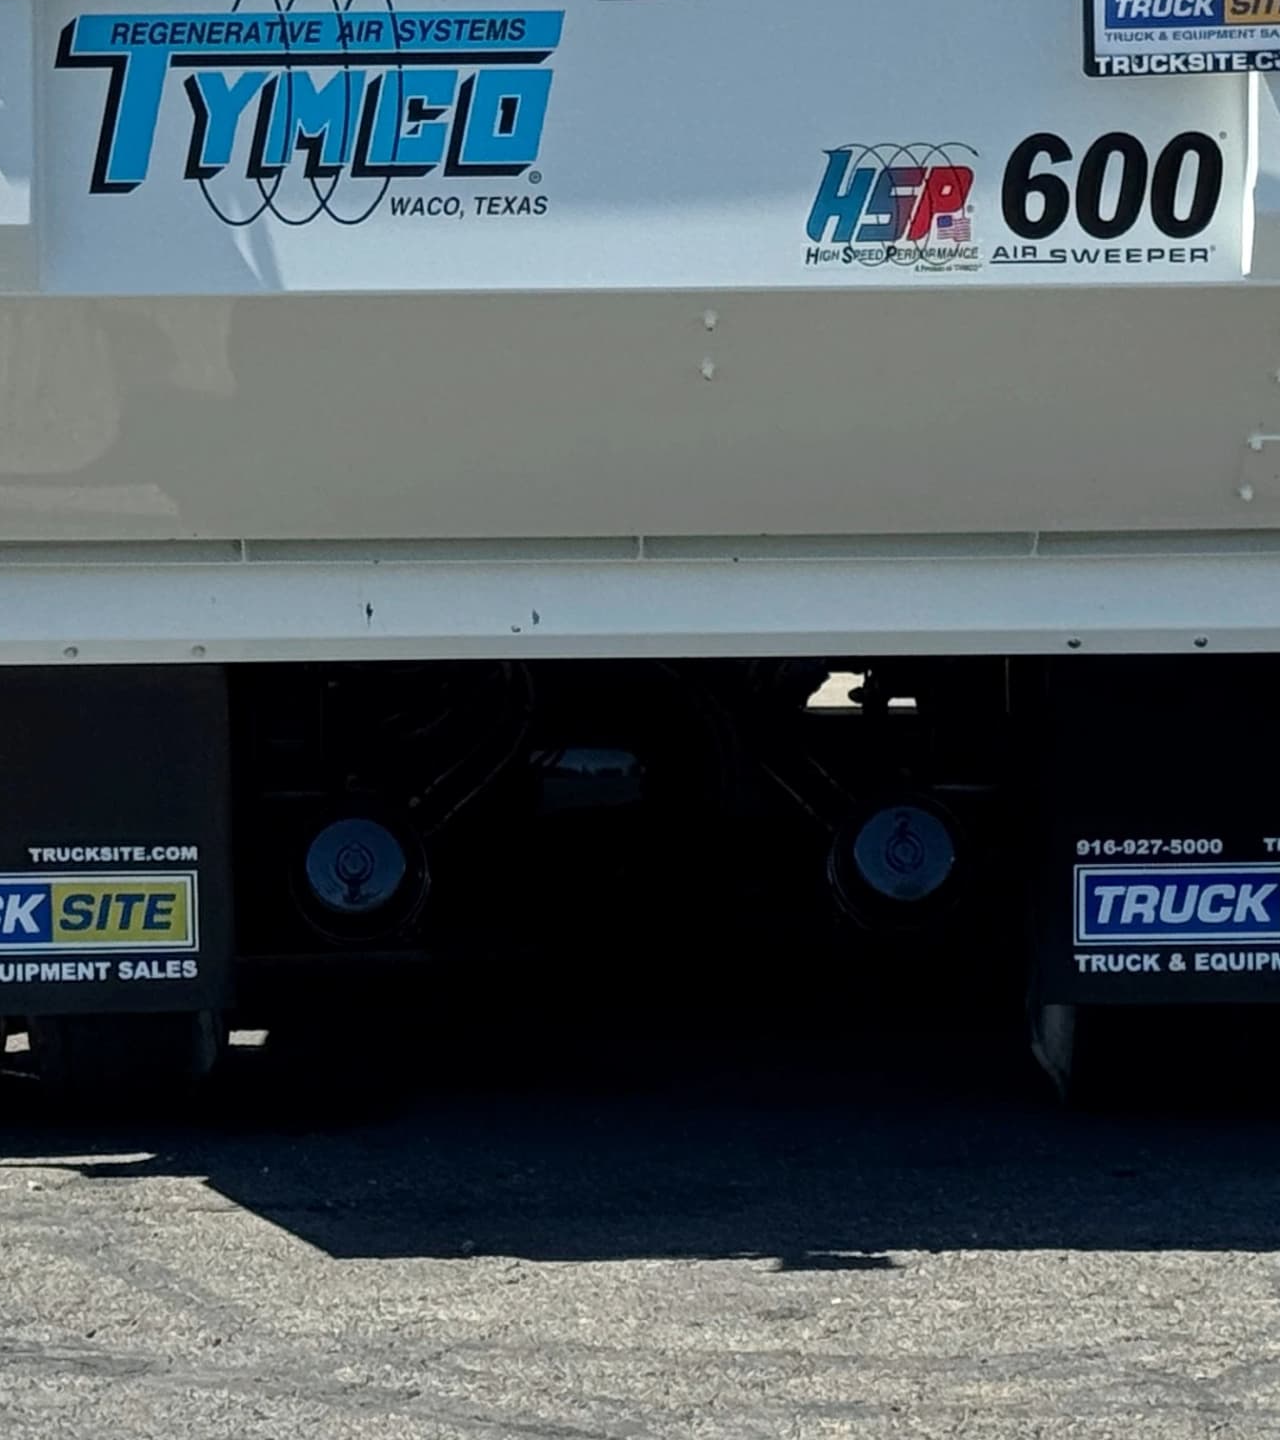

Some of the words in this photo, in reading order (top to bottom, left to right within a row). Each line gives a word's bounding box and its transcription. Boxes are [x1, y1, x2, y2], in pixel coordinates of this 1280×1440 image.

[111, 21, 320, 45] REGENERATIVE
[337, 21, 382, 45] AIR
[398, 19, 526, 42] SYSTEMS
[1105, 31, 1154, 42] TRUCK
[1158, 31, 1168, 41] &
[1173, 29, 1255, 41] EQUIPMENT
[54, 10, 565, 194] TYMCO
[806, 150, 974, 243] HSP
[1001, 132, 1223, 240] 600
[391, 197, 465, 218] WACO,
[474, 196, 548, 216] TEXAS
[992, 246, 1038, 260] AIR
[1050, 247, 1209, 264] SWEEPER
[28, 846, 198, 862] TRUCKSITE.COM
[1076, 838, 1223, 855] 916-927-5000
[60, 893, 176, 931] SITE
[1094, 883, 1278, 925] TRUCK
[118, 960, 198, 980] SALES
[1074, 954, 1161, 972] TRUCK
[1168, 954, 1186, 971] &
